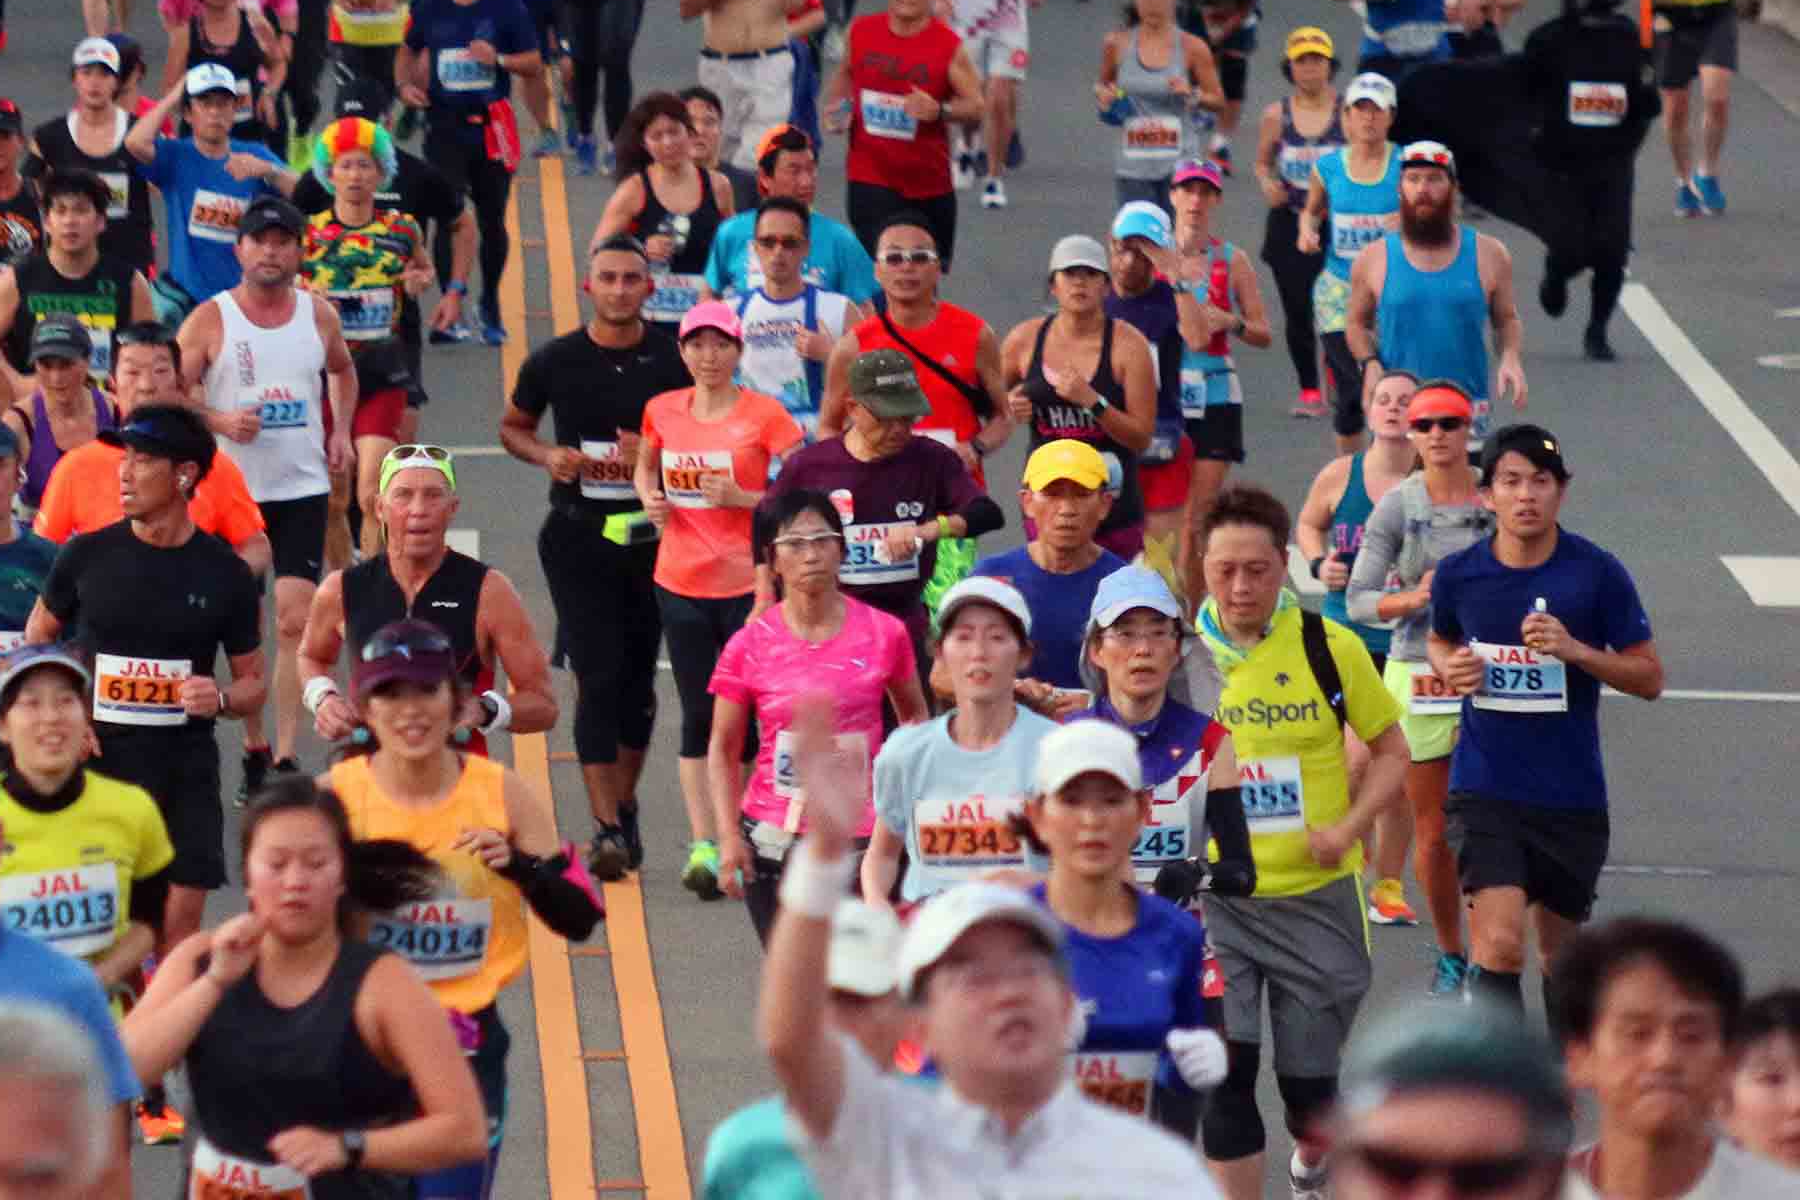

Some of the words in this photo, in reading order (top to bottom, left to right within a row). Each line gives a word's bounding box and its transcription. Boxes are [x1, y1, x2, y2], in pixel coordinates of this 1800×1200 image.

[256, 402, 303, 422] 227
[675, 454, 710, 468] JAL
[1493, 646, 1539, 666] JAL
[120, 660, 167, 678] JAL
[1491, 667, 1544, 691] 878
[107, 680, 176, 705] 6121
[941, 803, 993, 824] JAL
[31, 872, 90, 898] JAL
[6, 892, 115, 932] 24013
[400, 903, 463, 923] JAL
[369, 923, 486, 956] 24014
[214, 1161, 271, 1194] JAL
